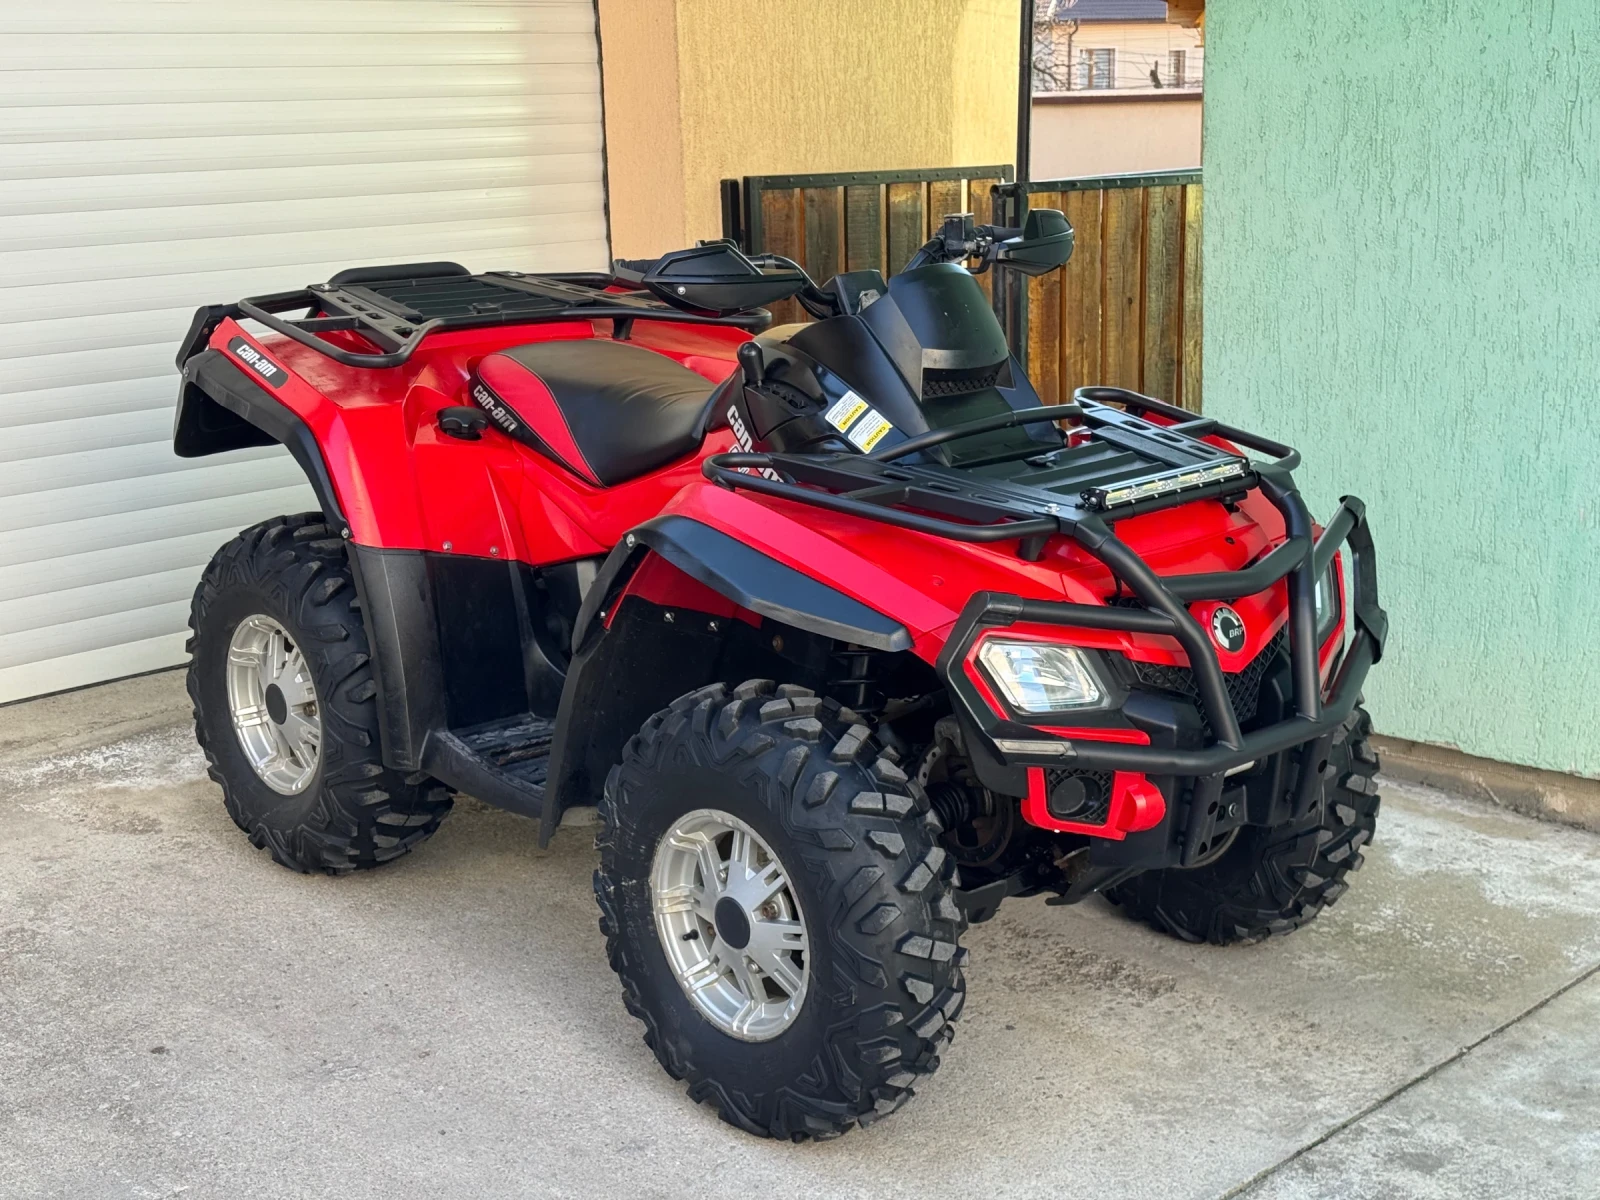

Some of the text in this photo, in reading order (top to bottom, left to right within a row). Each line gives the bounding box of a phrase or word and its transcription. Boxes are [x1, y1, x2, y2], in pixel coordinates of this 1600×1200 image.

[236, 344, 277, 377] can-am
[473, 385, 518, 432] can-am
[842, 405, 862, 426] CAUTION
[866, 426, 886, 446] CAUTION
[1229, 627, 1244, 638] BRP
